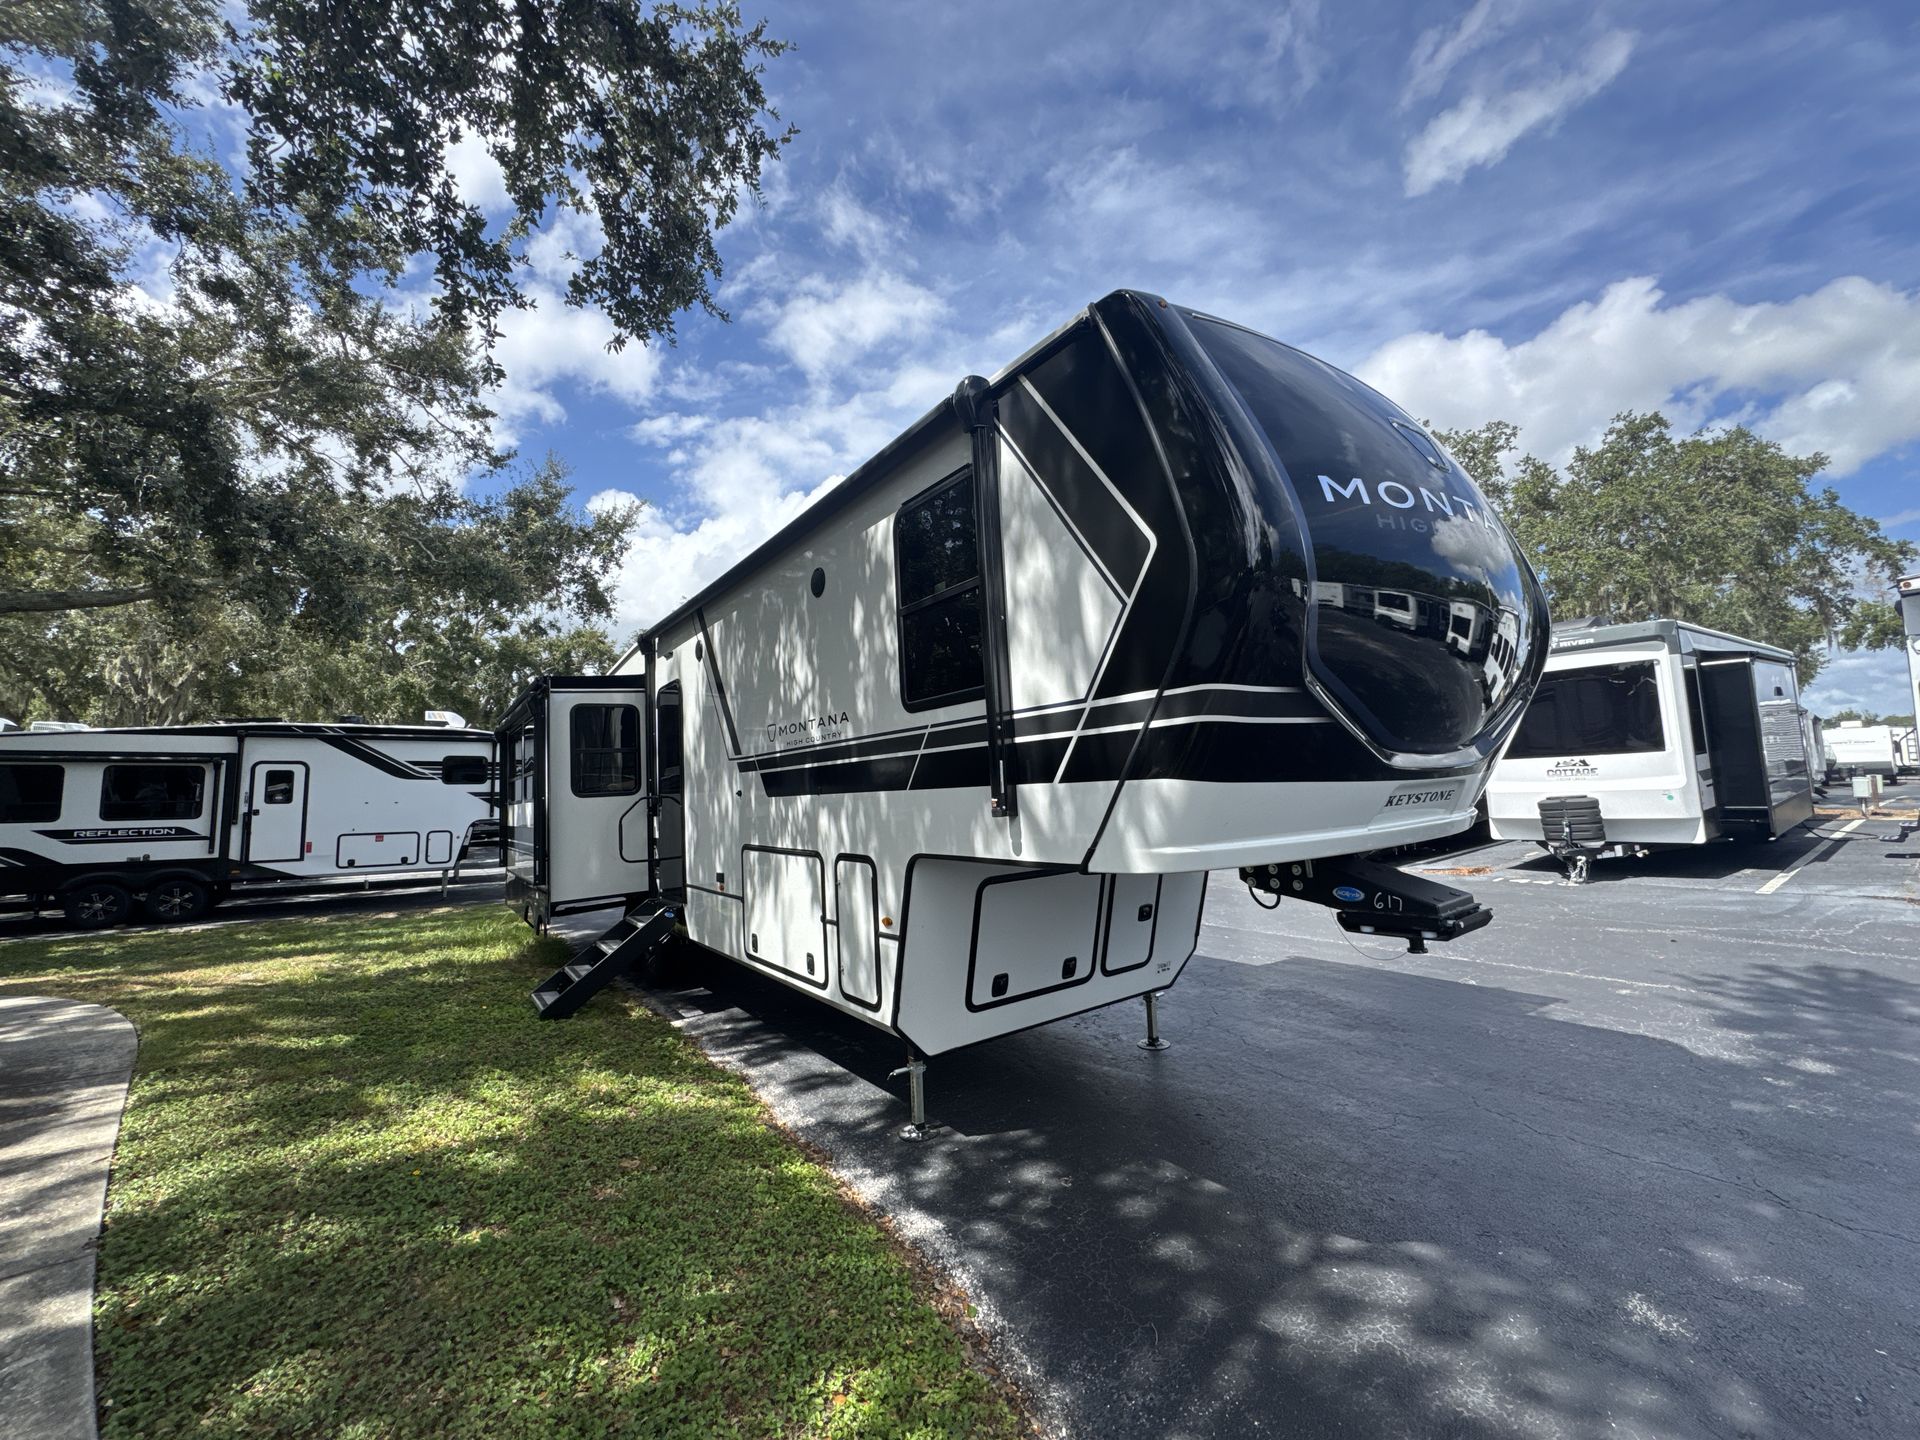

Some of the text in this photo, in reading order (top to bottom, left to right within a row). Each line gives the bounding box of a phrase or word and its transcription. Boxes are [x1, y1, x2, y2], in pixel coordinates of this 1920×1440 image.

[778, 711, 849, 737] MONTANA
[786, 731, 842, 747] HIGH COUNTRY
[1546, 767, 1599, 777] COTTAGE
[1384, 789, 1455, 808] KEYSTONE
[73, 828, 176, 838] REFLECTION
[1373, 891, 1403, 912] 617
